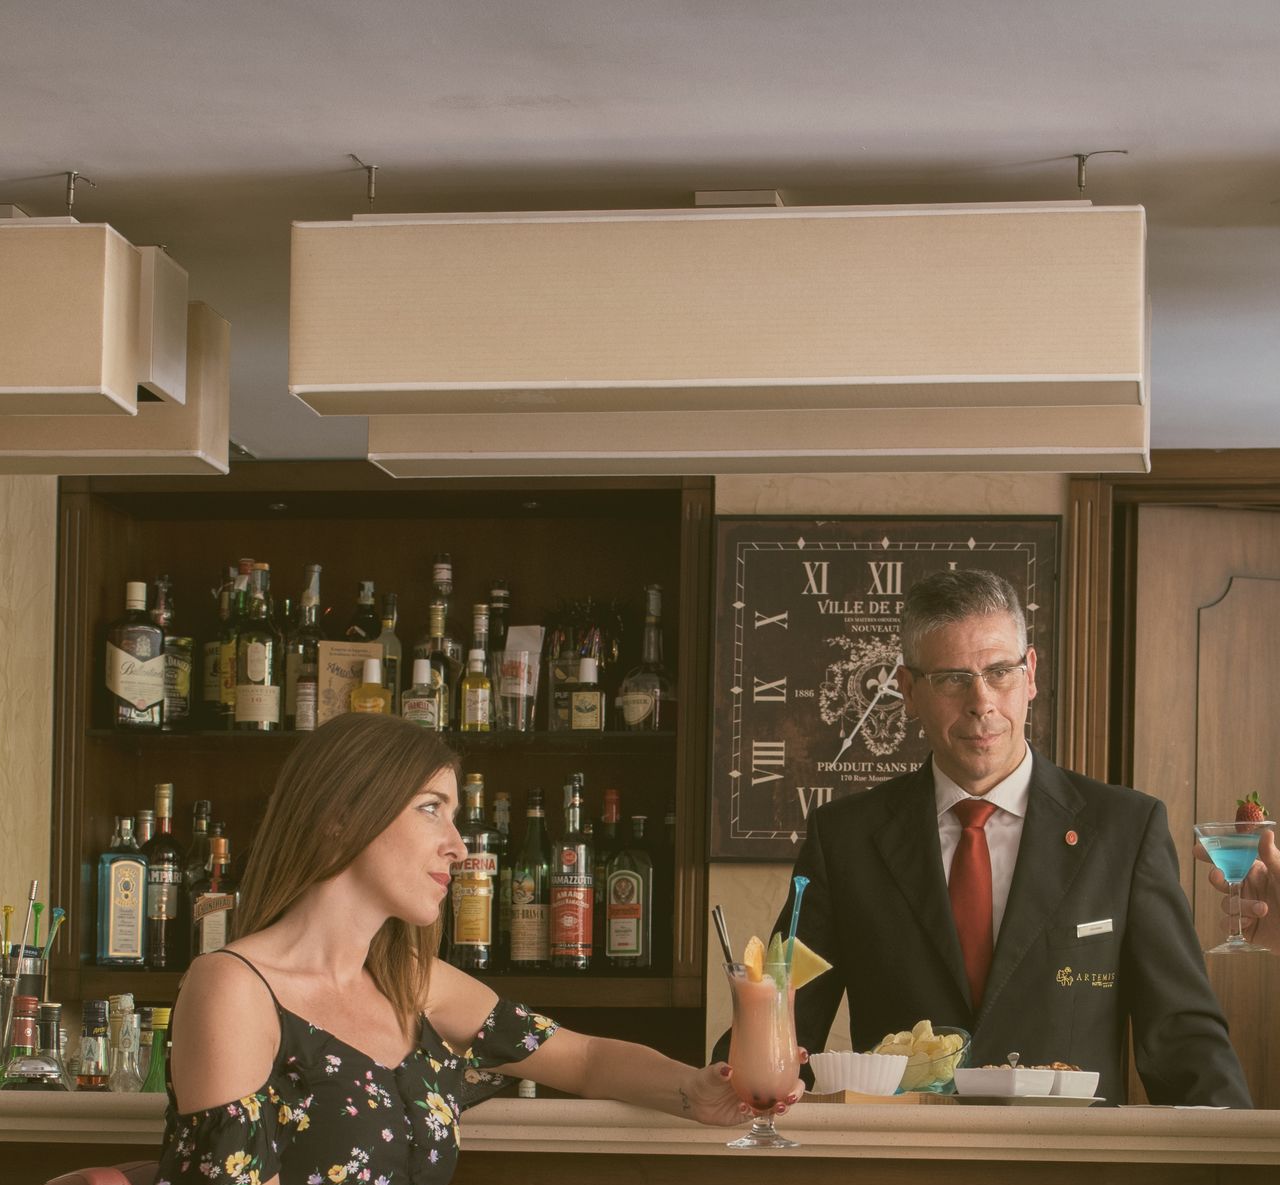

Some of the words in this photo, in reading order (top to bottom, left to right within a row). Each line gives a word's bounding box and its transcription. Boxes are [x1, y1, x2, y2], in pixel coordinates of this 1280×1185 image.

[801, 561, 830, 595] XI
[867, 561, 904, 595] XII
[818, 600, 864, 614] VILLE
[869, 601, 891, 614] DE
[896, 601, 905, 614] P
[794, 690, 815, 698] 1886
[817, 762, 874, 772] PRODUIT
[876, 763, 906, 772] SANS
[451, 858, 496, 871] AVERNA
[556, 890, 585, 900] AMARO
[1076, 972, 1115, 982] ARTEMIS
